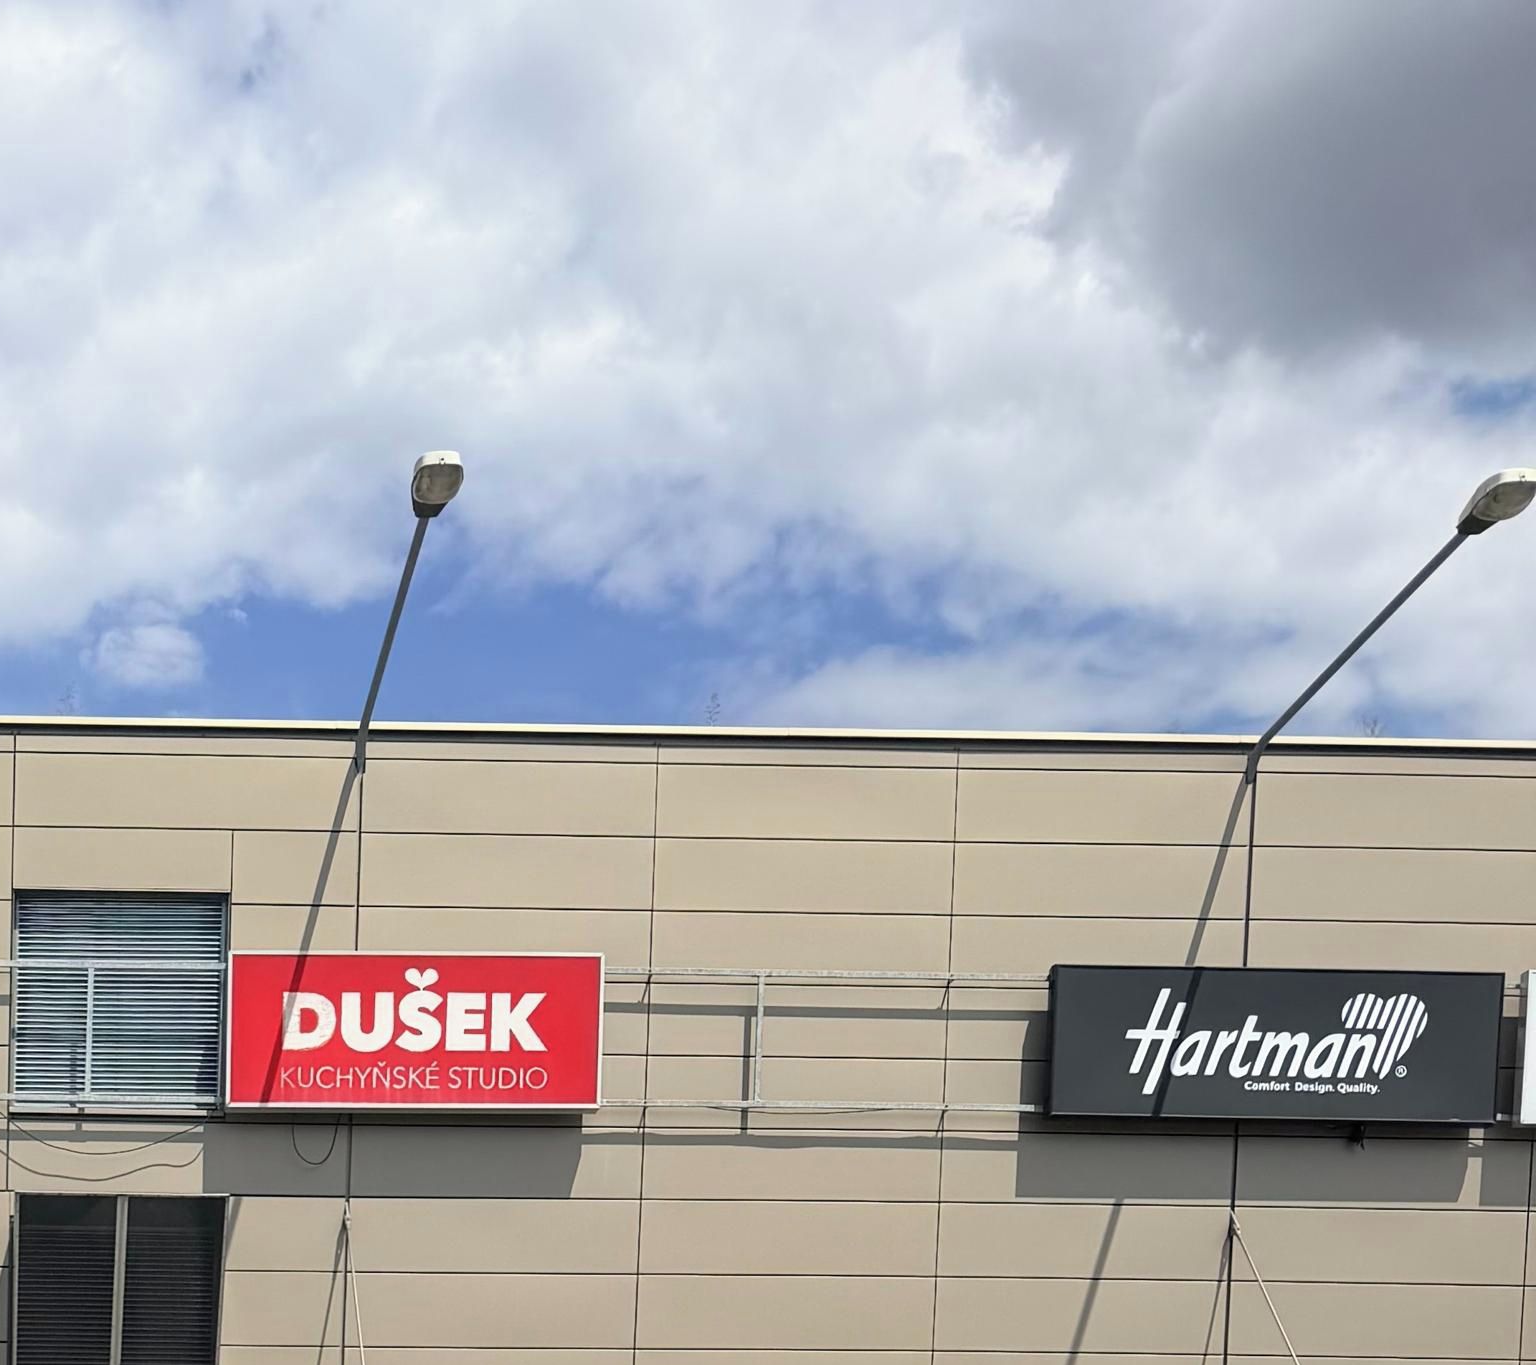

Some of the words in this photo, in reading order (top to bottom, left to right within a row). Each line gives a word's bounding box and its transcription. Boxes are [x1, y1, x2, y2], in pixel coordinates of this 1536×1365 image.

[280, 968, 548, 1052] DUŠEK
[1125, 988, 1378, 1095] Hartman
[280, 1061, 440, 1089] KUCHYŇSKÉ
[448, 1066, 548, 1090] STUDIO
[1244, 1081, 1290, 1092] Comfort
[1294, 1081, 1335, 1094] Design.
[1337, 1082, 1381, 1095] Quality.
